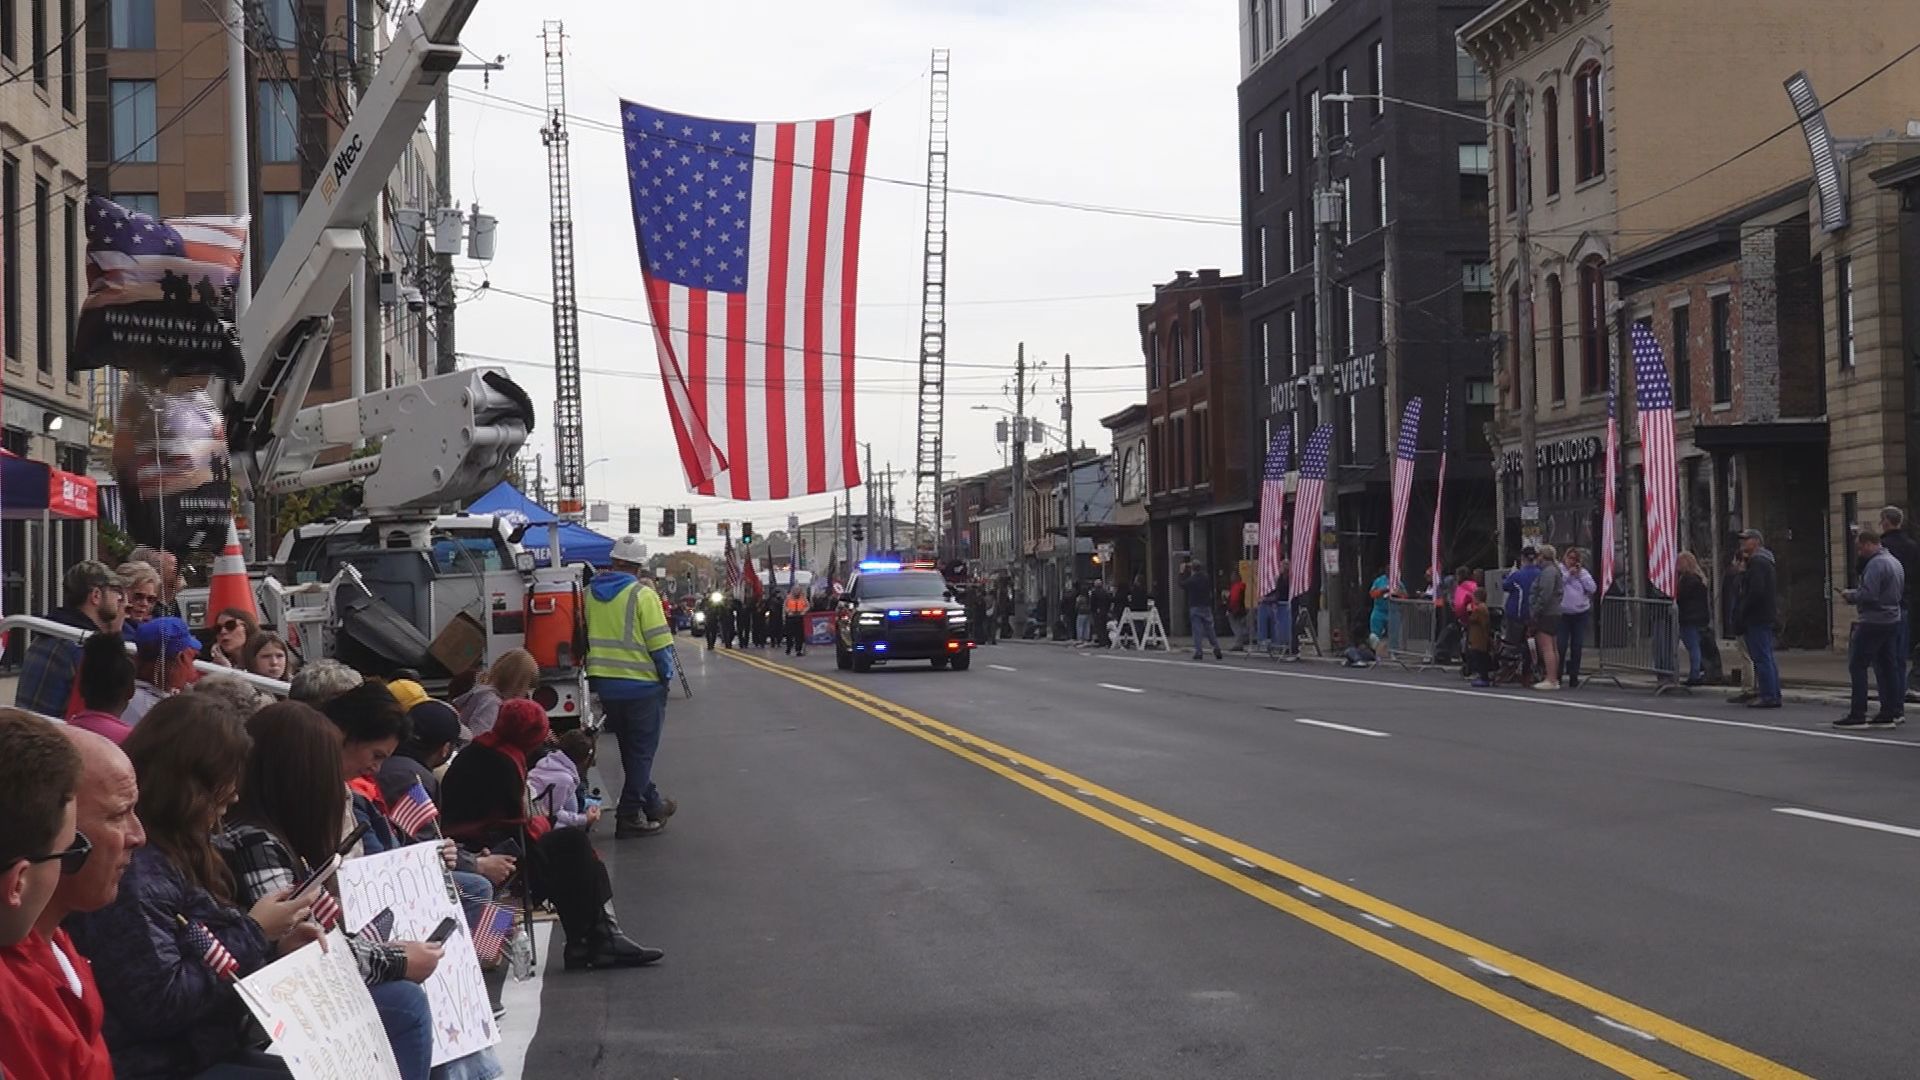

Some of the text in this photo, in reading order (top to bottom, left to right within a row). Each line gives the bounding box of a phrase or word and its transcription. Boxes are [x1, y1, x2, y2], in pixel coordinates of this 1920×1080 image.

[333, 133, 363, 187] Altec
[105, 311, 197, 331] HONORING
[112, 330, 223, 349] WHO SERVED
[1310, 352, 1376, 402] GEVIEVE
[1550, 437, 1588, 465] LIQUORS
